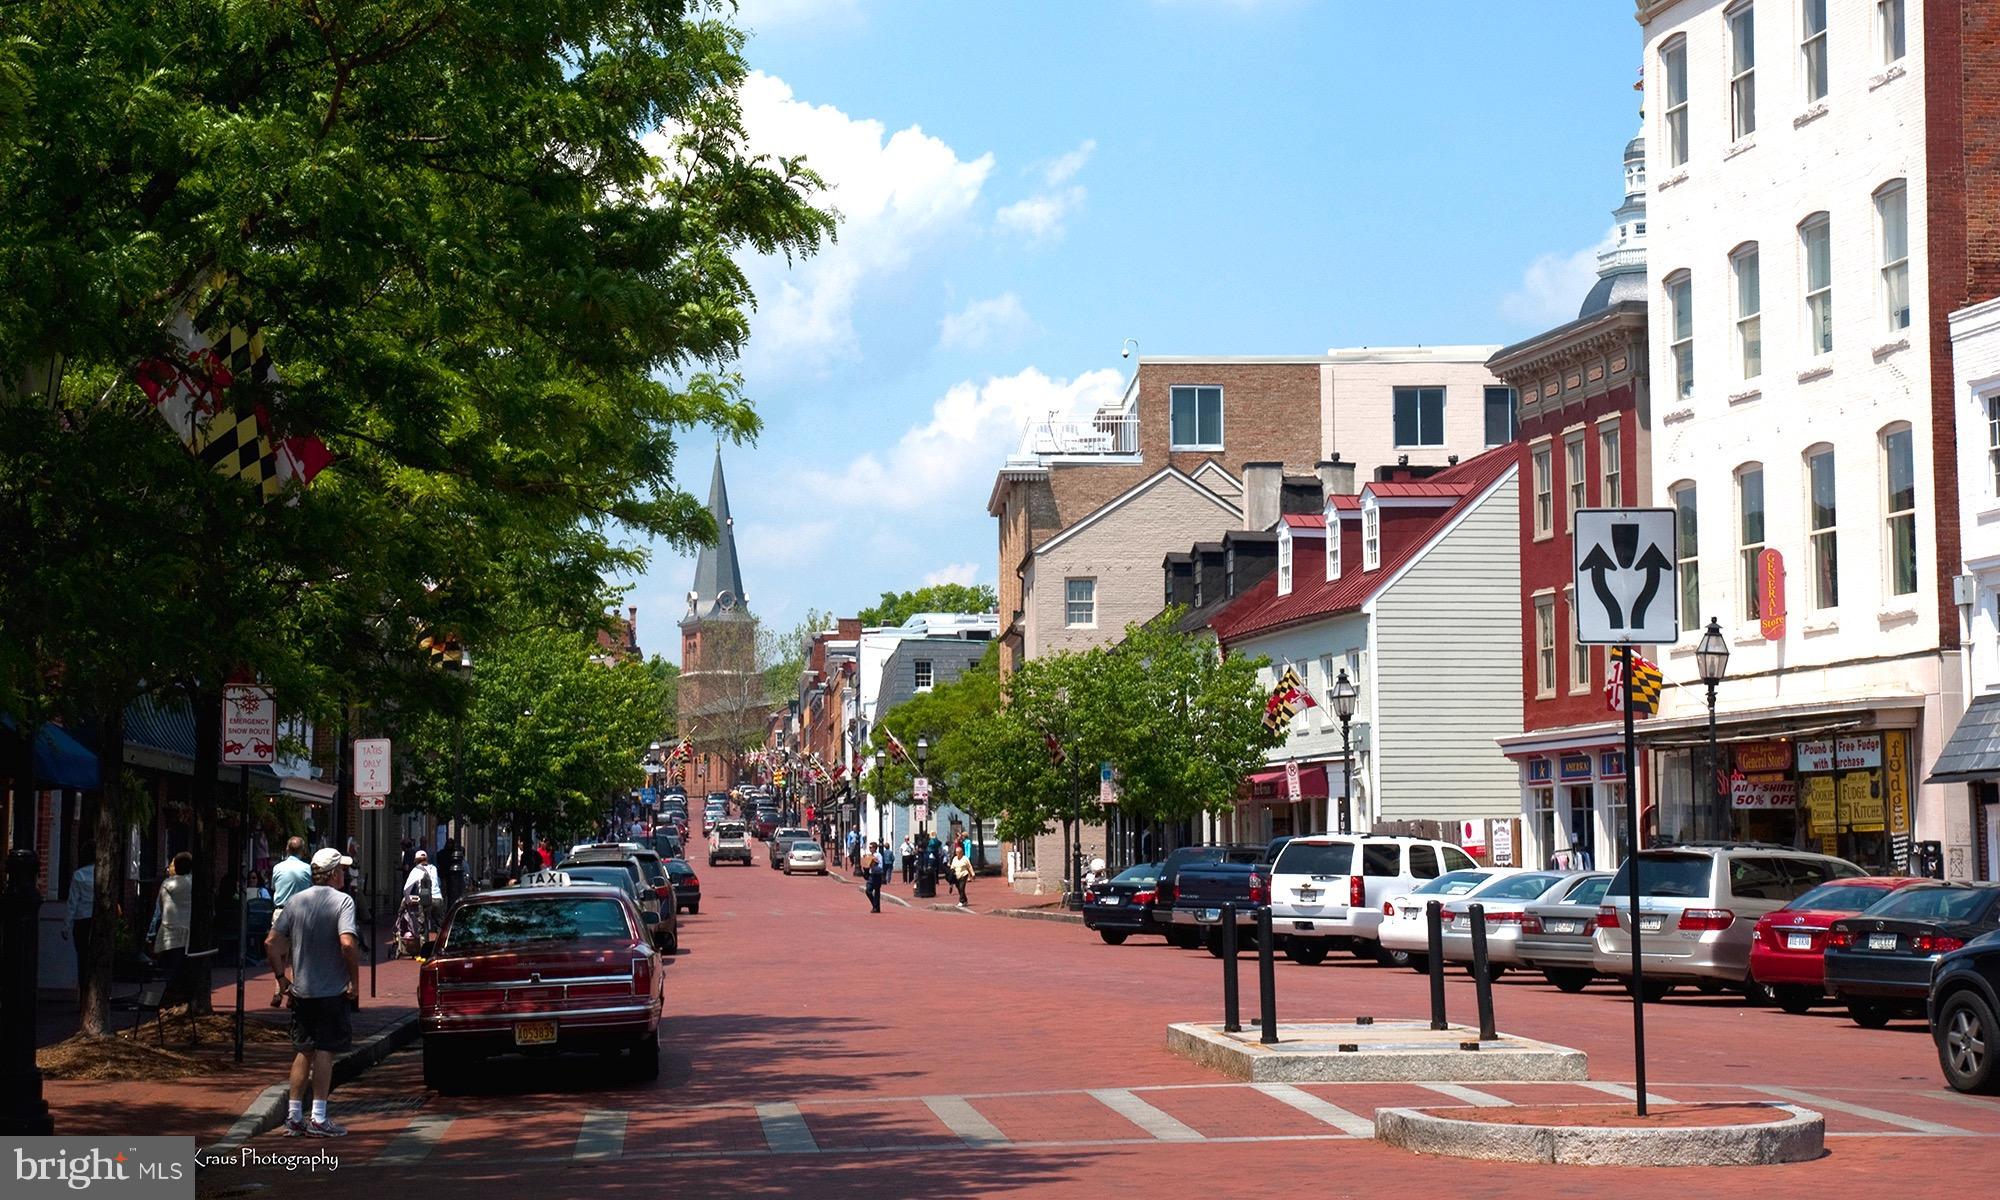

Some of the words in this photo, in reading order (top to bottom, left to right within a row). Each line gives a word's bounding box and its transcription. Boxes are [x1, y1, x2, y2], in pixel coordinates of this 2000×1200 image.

[1766, 552, 1777, 617] GENERAL
[1762, 616, 1784, 629] Store
[229, 718, 269, 726] EMERGENCY
[228, 727, 247, 735] SNOW
[248, 727, 271, 735] ROUTE
[362, 746, 383, 755] TAXIS
[1804, 744, 1827, 755] Pound
[1839, 741, 1855, 753] Free
[1857, 739, 1880, 753] Fudge
[362, 759, 381, 768] ONLY
[1743, 752, 1767, 770] General
[1813, 759, 1829, 769] with
[370, 769, 375, 780] 2
[1734, 784, 1748, 792] All
[1843, 784, 1867, 799] FUDGE
[1736, 795, 1764, 805] 50%
[1771, 794, 1797, 805] OFF
[527, 872, 563, 884] TAXI
